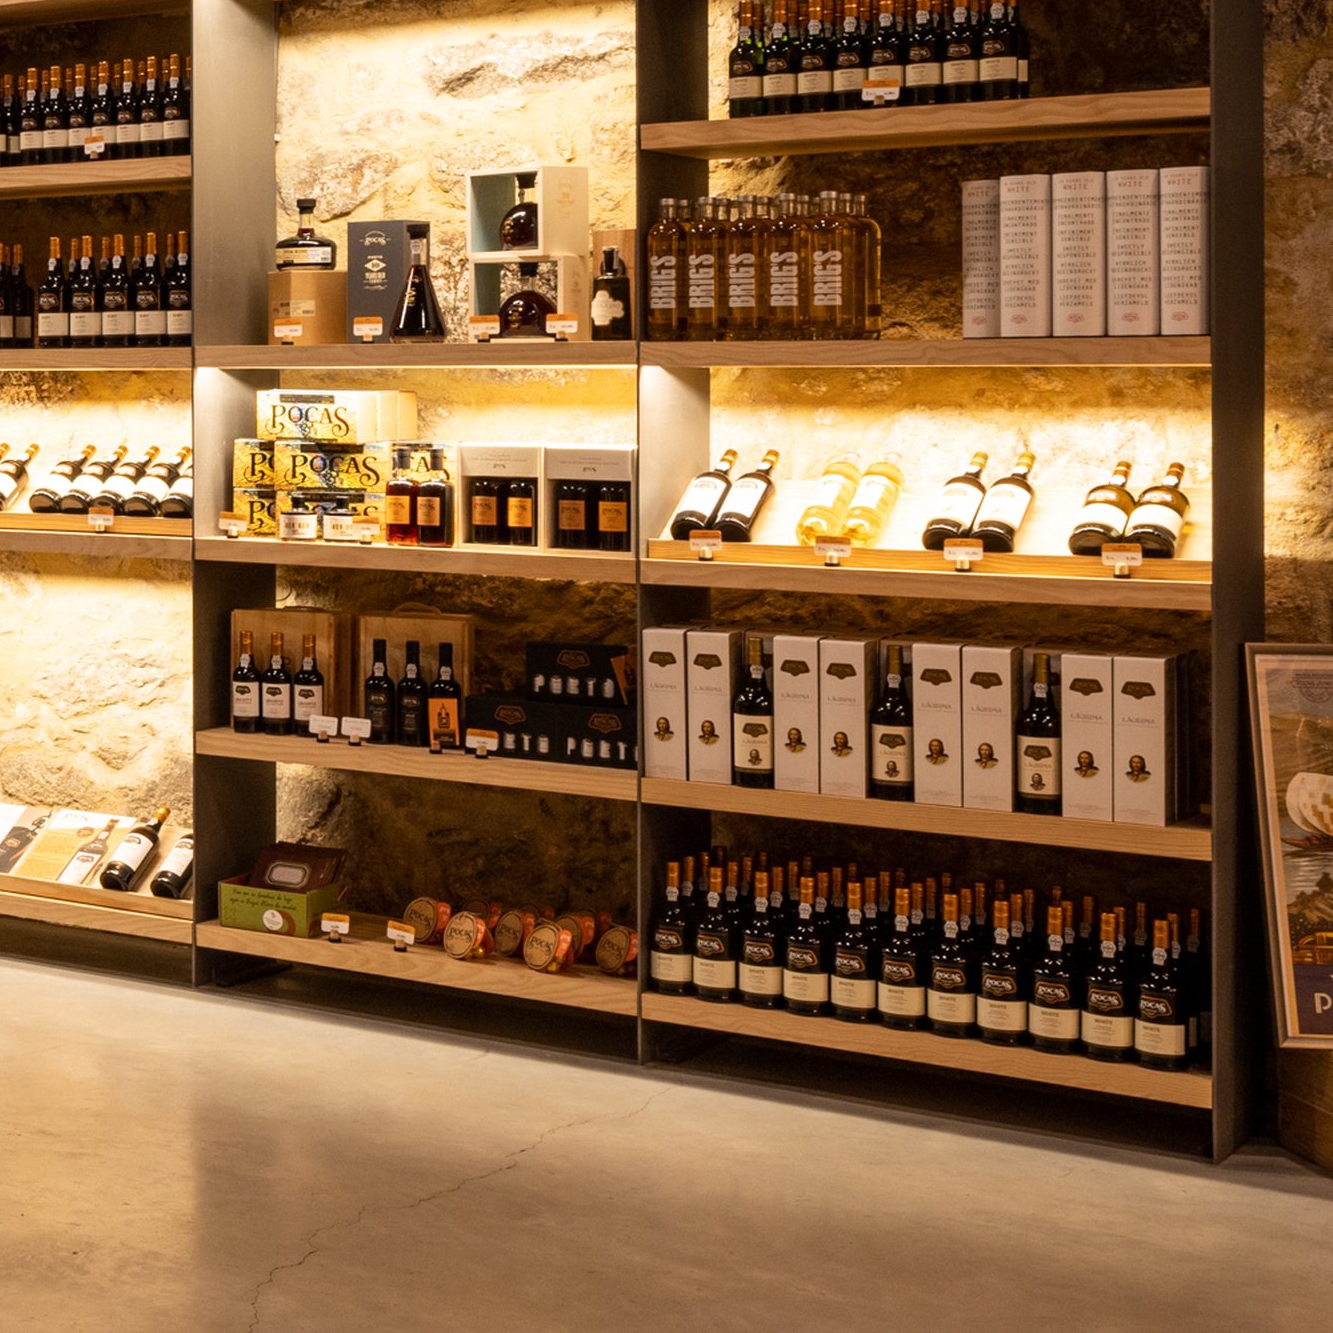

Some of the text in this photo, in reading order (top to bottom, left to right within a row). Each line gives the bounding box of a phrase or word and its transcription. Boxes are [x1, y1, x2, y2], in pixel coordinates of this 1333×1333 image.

[650, 255, 676, 309] BRIG'S
[688, 253, 715, 308] BRIG'S
[728, 252, 756, 308] BRIG'S
[770, 251, 799, 307] BRIG'S
[813, 249, 842, 306] BRIG'S
[266, 405, 350, 437] POÇAS
[284, 453, 380, 487] POÇAS
